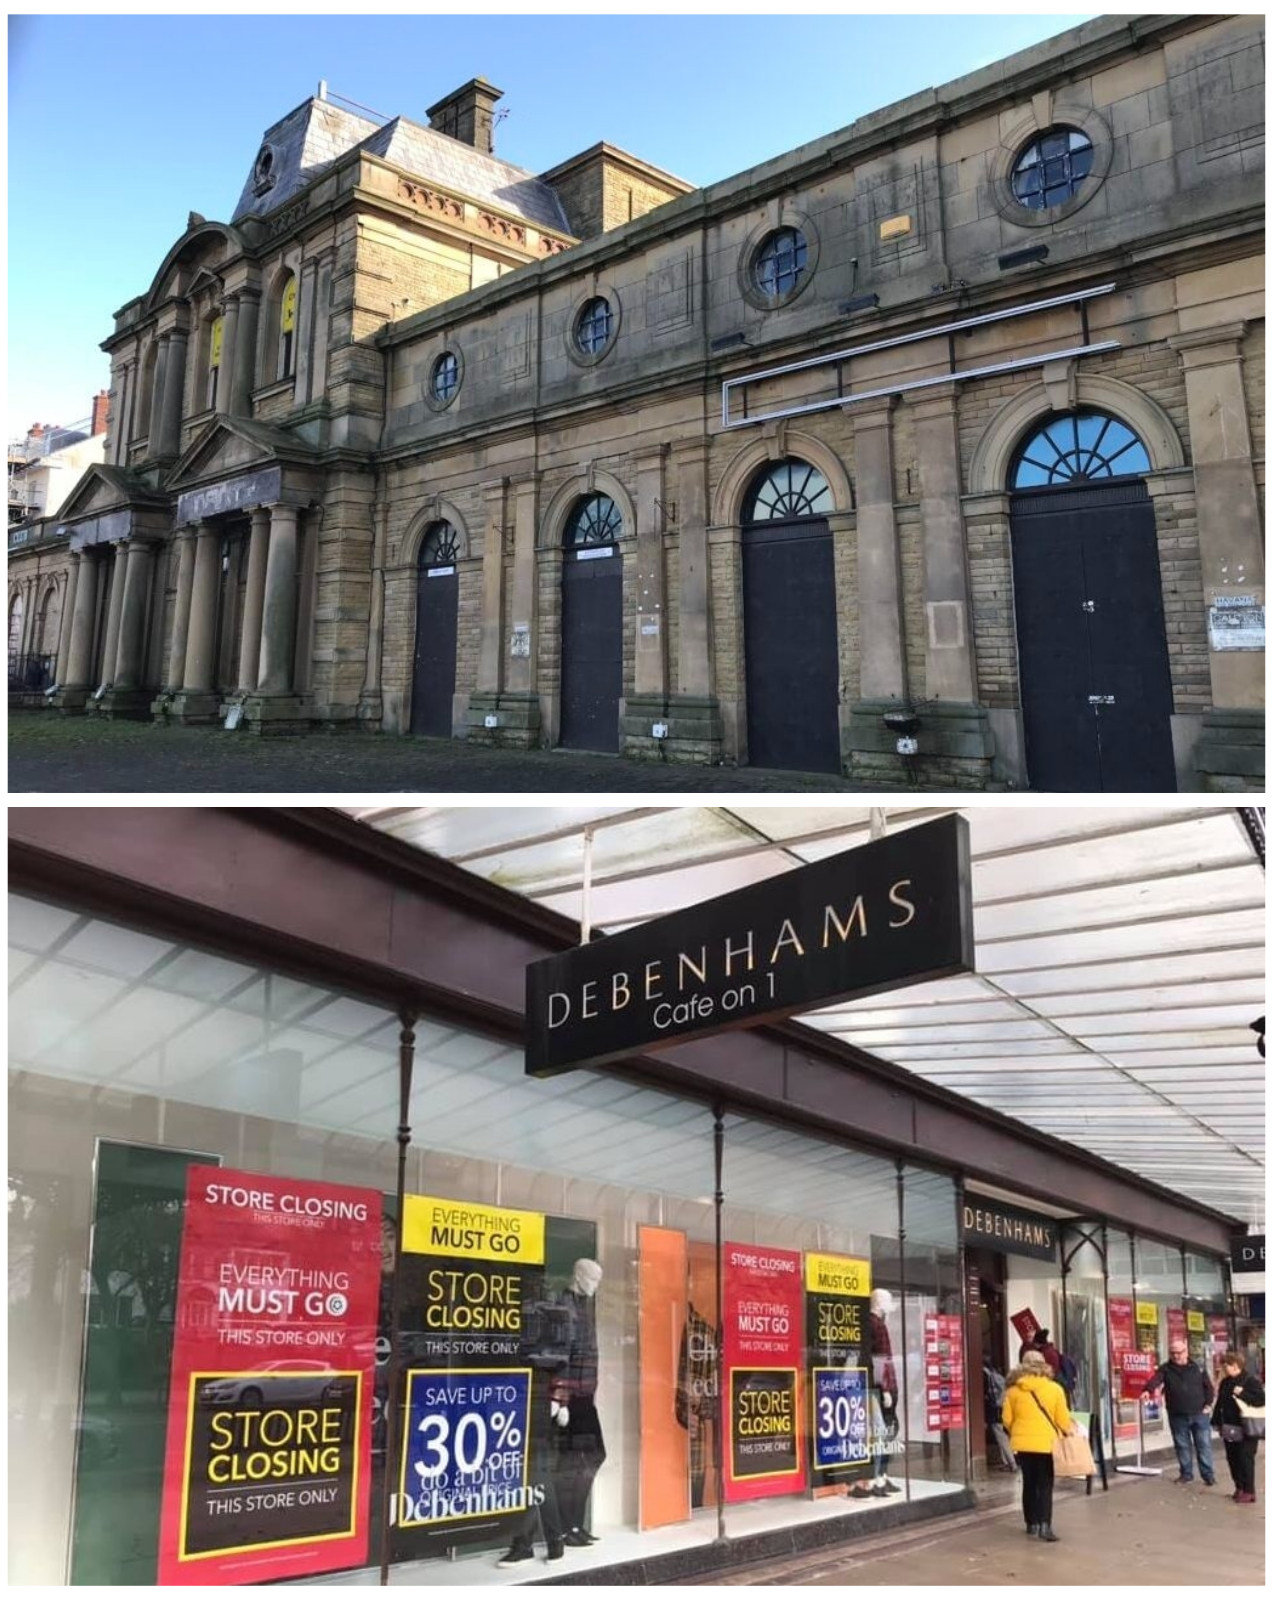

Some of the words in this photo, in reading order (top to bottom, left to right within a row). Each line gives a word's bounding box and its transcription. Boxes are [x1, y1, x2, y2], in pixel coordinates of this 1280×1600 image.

[547, 878, 916, 1029] DEBENHAMS
[652, 995, 713, 1029] Cafe
[721, 984, 755, 1010] on
[765, 972, 775, 998] 1
[205, 1184, 274, 1211] STORE
[280, 1195, 367, 1221] CLOSING
[254, 1213, 271, 1224] THIS
[274, 1216, 301, 1227] STORE
[303, 1218, 325, 1228] ONLY
[431, 1207, 521, 1233] EVERYTHING
[963, 1207, 1051, 1248] DEBENHAMS
[431, 1226, 485, 1250] MUST
[489, 1234, 520, 1253] GO
[731, 1253, 759, 1269] STORE
[760, 1257, 795, 1273] CLOSING
[220, 1263, 349, 1290] EVERYTHING
[427, 1270, 521, 1305] STORE
[817, 1273, 842, 1288] MUST
[843, 1276, 859, 1290] GO
[219, 1287, 299, 1314] MUST
[305, 1292, 348, 1317] GO
[738, 1301, 789, 1317] EVERYTHING
[818, 1301, 861, 1325] STORE
[426, 1304, 521, 1330] CLOSING
[738, 1316, 771, 1333] MUST
[772, 1317, 789, 1334] GO
[218, 1328, 252, 1345] THIS
[256, 1330, 303, 1346] STORE
[307, 1331, 346, 1346] ONLY
[426, 1341, 450, 1354] THIS
[452, 1341, 489, 1355] STORE
[491, 1342, 520, 1355] ONLY
[1123, 1353, 1152, 1364] STORE
[425, 1387, 467, 1406] SAVE
[471, 1387, 492, 1404] UP
[495, 1385, 517, 1403] TO
[738, 1390, 791, 1415] STORE
[210, 1408, 342, 1450] STORE
[738, 1416, 792, 1434] CLOSING
[818, 1396, 865, 1439] 30%
[414, 1411, 521, 1478] 30%
[738, 1444, 753, 1455] THIS
[754, 1443, 773, 1453] STORE
[774, 1441, 791, 1452] ONLY
[207, 1447, 340, 1482] CLOSING
[489, 1451, 521, 1470] OFF
[207, 1498, 242, 1516] THIS
[246, 1493, 295, 1511] STORE
[299, 1488, 338, 1505] ONLY
[389, 1484, 545, 1527] Debenhams
